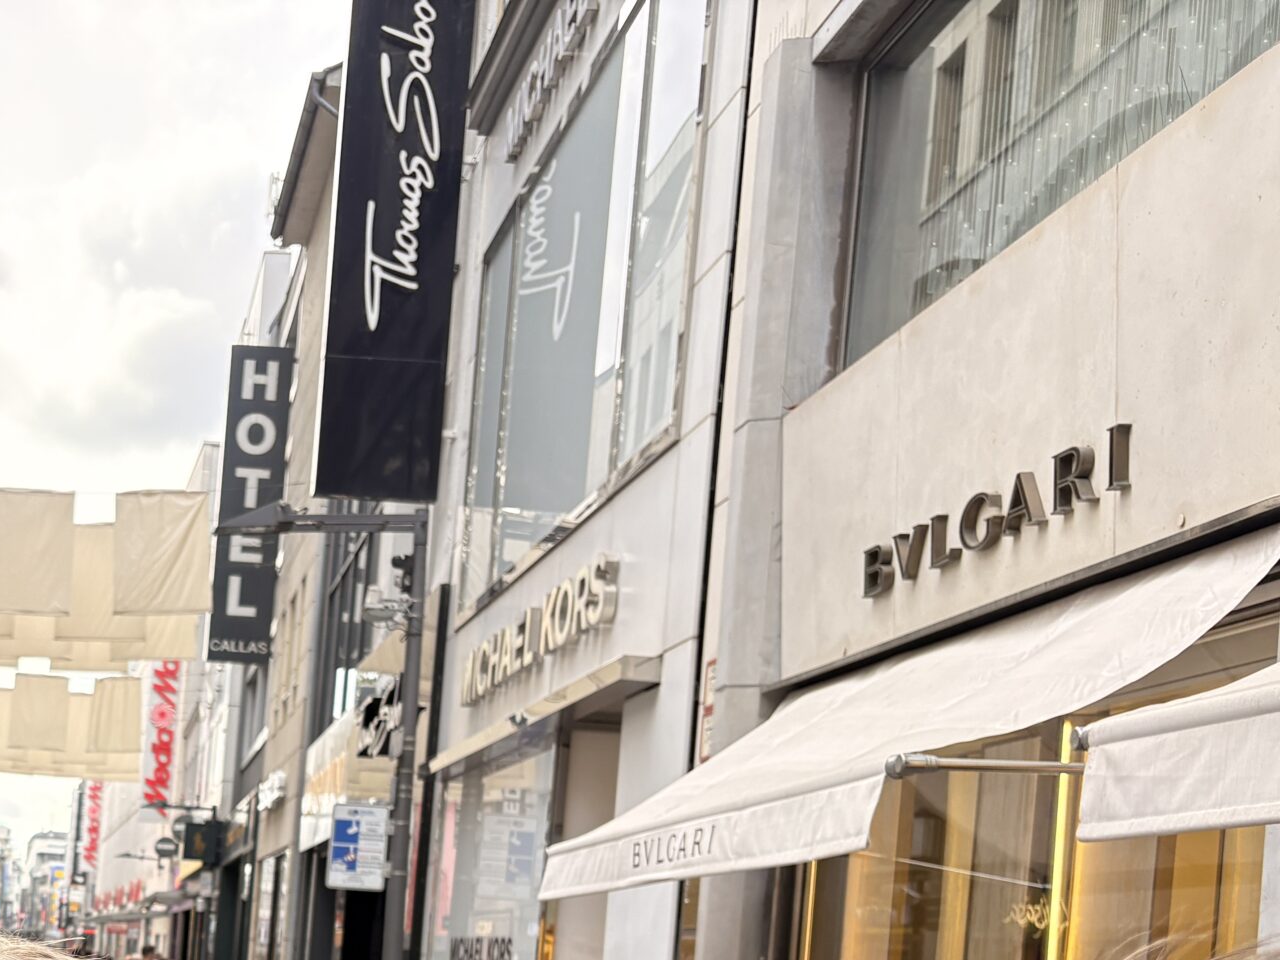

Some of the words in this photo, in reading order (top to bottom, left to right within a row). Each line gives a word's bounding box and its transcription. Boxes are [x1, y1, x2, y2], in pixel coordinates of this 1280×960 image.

[380, 0, 441, 162] Sabo
[364, 150, 434, 331] Thomas
[225, 357, 280, 618] HOTEL
[862, 423, 1133, 598] BVLGARI
[209, 639, 269, 655] CALLAS
[462, 607, 540, 707] MICHAEL
[539, 552, 617, 657] KORS
[631, 825, 717, 869] BVLGARI
